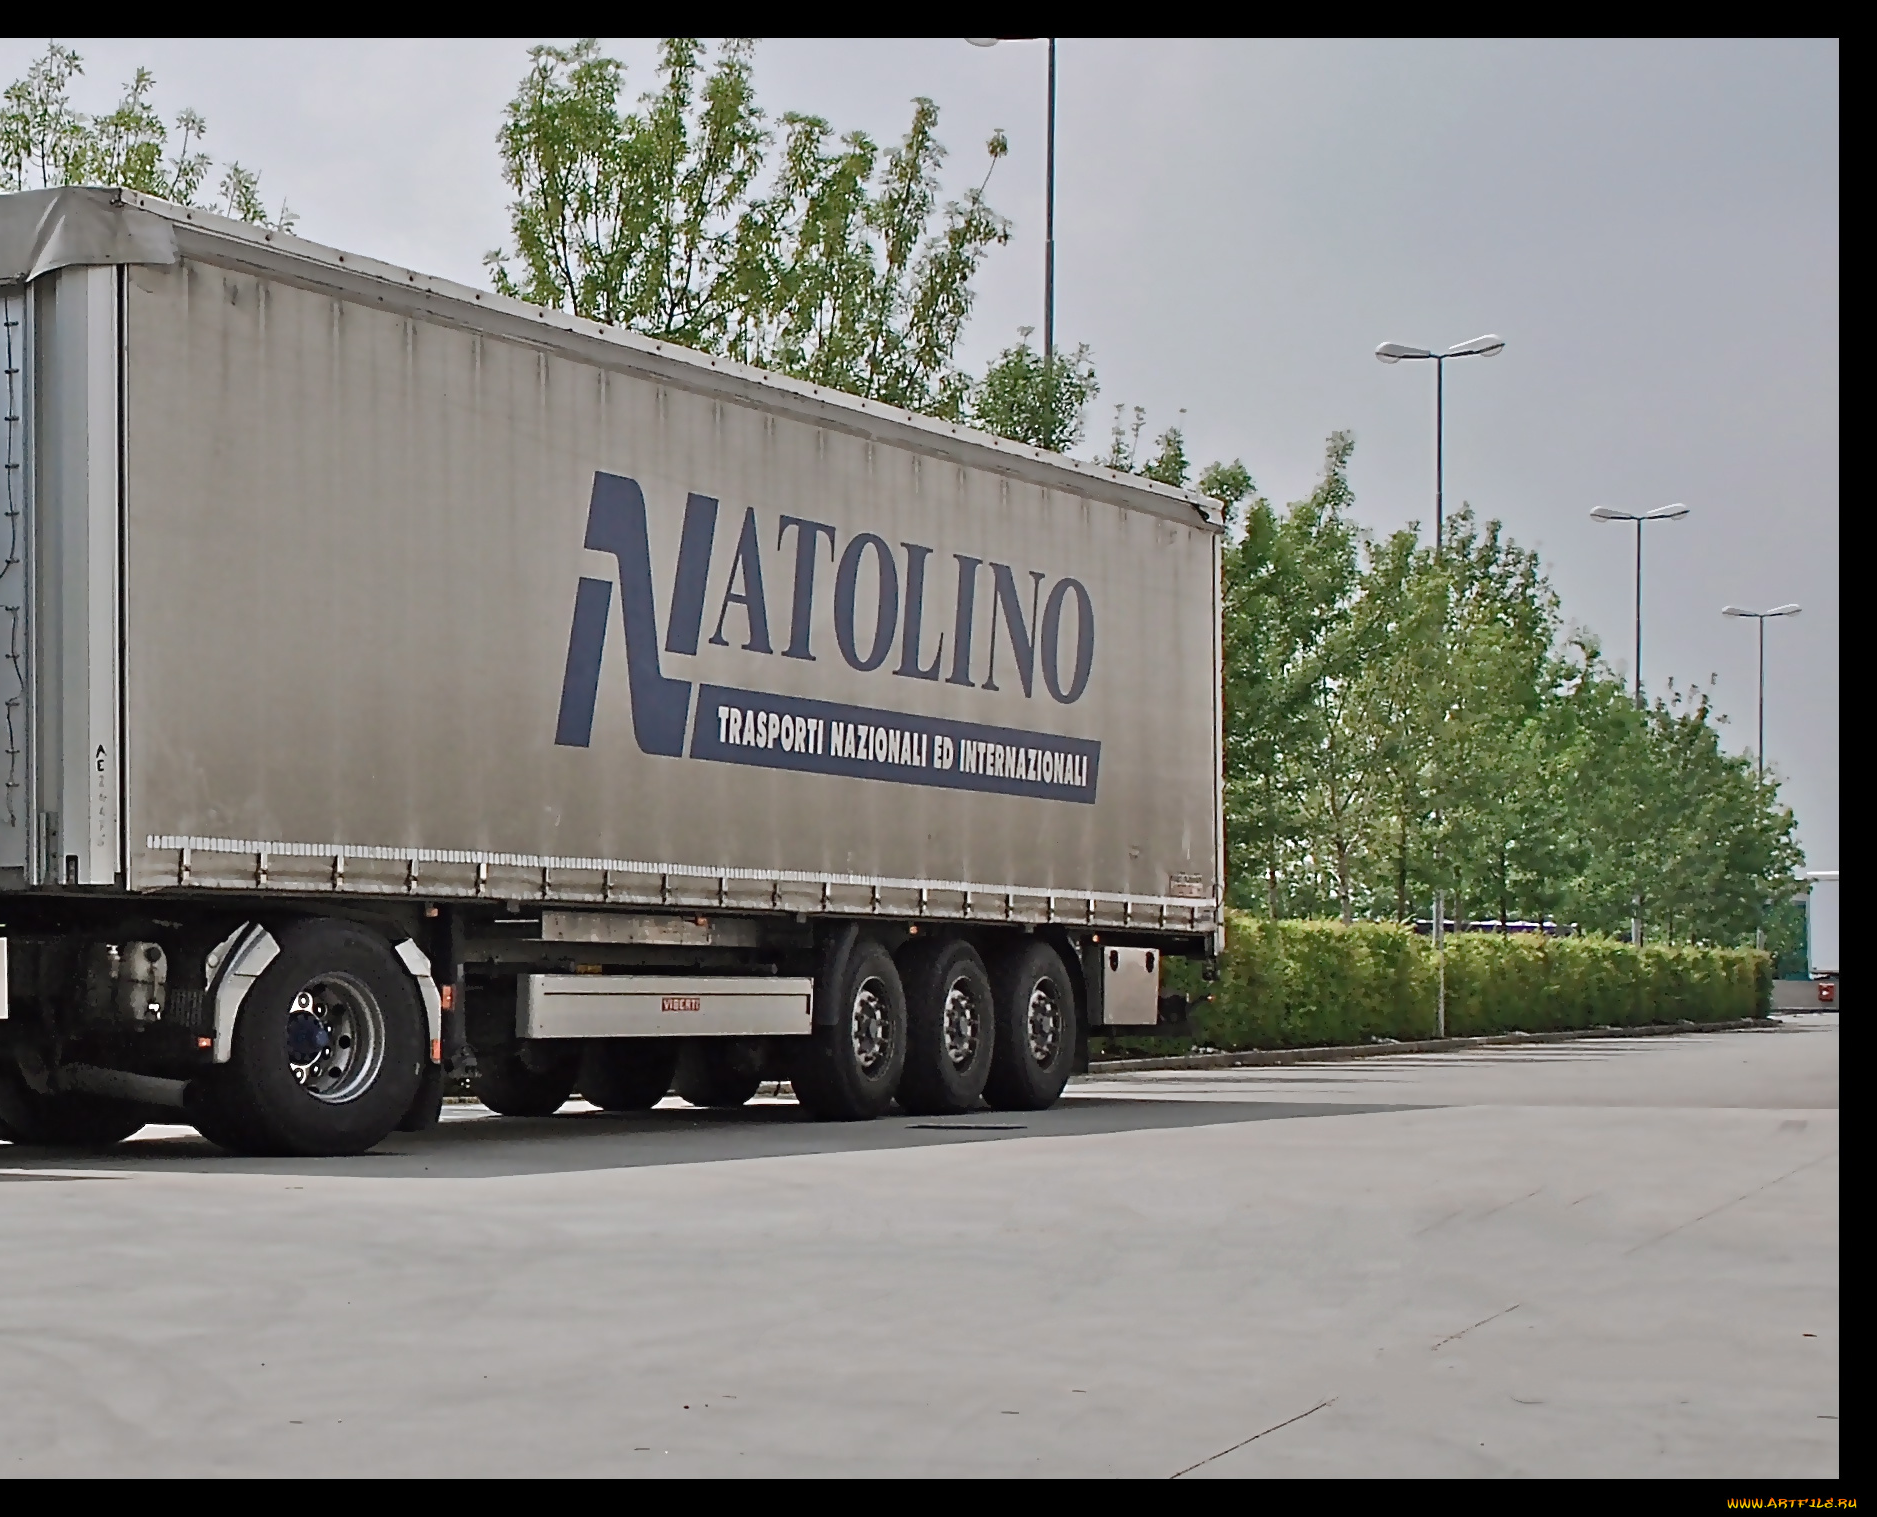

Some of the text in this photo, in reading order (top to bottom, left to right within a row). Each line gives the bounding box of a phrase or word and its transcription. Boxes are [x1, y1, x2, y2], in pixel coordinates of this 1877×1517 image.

[554, 470, 1095, 758] NATOLINO
[717, 706, 1088, 787] TRASPORTI NAZIONALI ED INTERNAZIONALI
